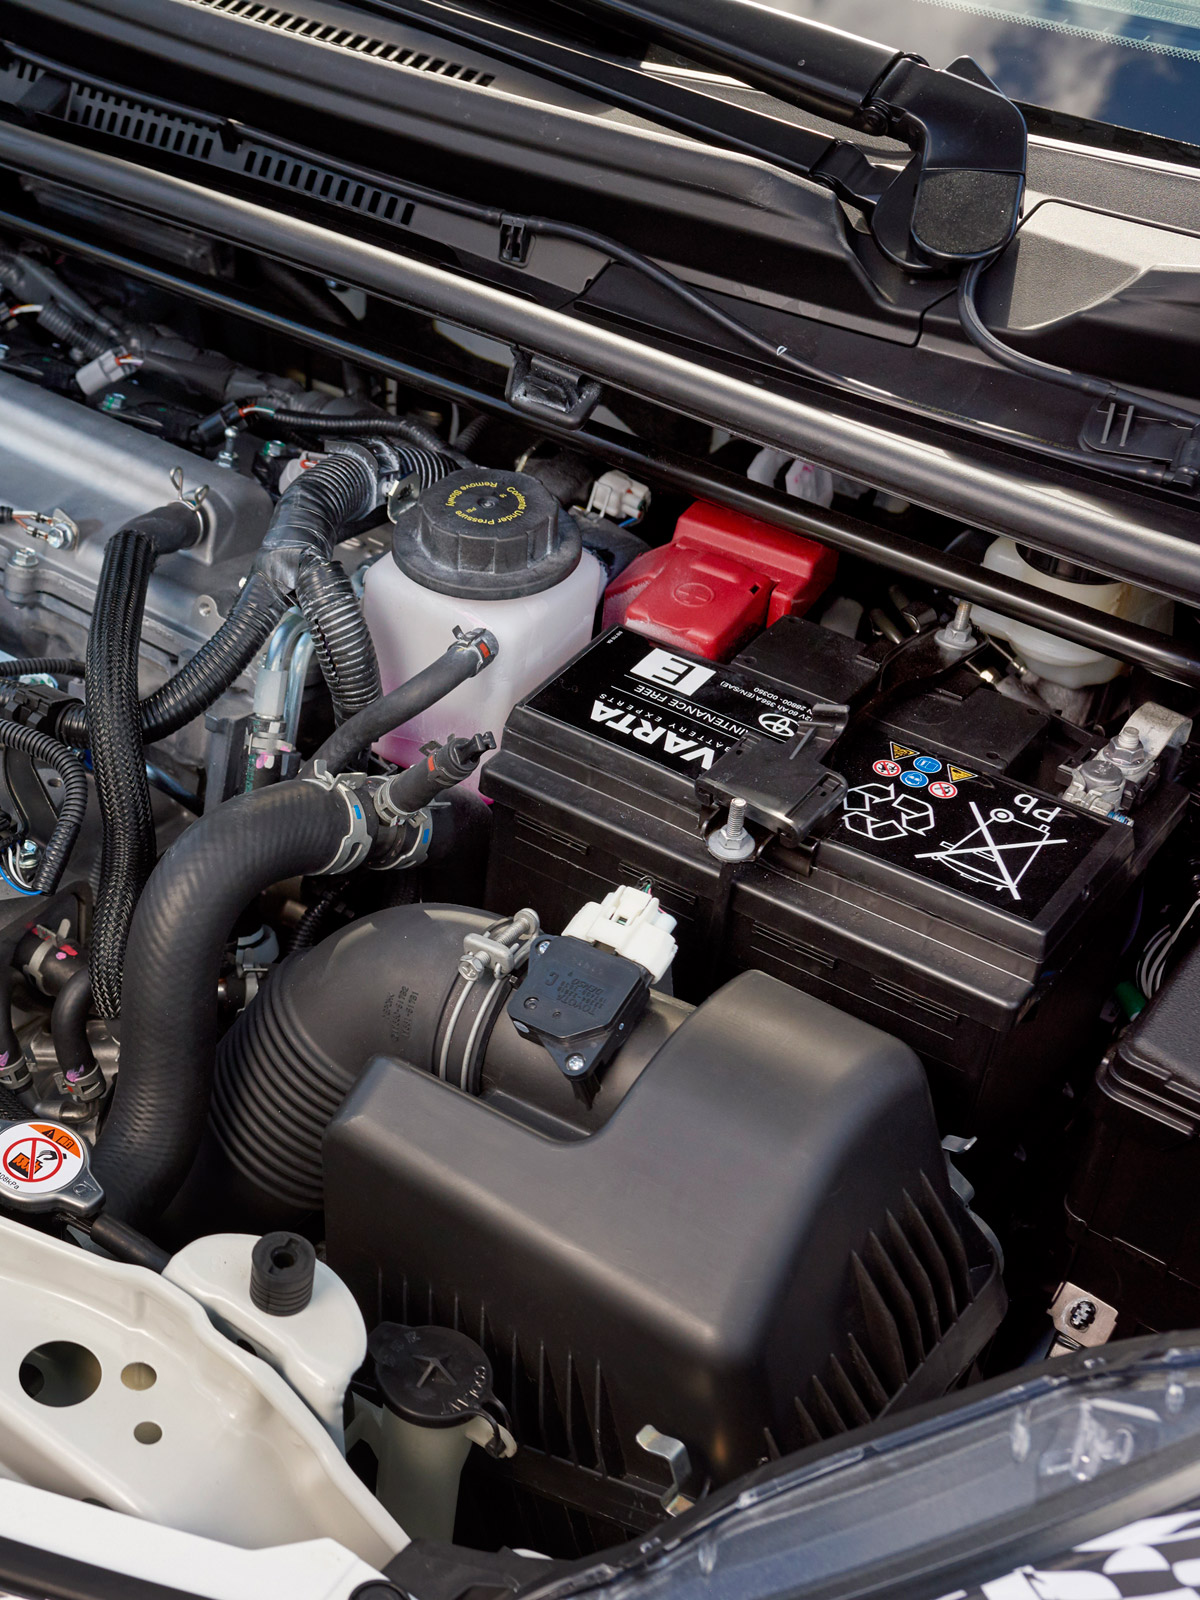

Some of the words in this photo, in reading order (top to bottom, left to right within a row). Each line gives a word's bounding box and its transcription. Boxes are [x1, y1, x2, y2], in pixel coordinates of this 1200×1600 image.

[460, 481, 498, 490] Remove
[444, 489, 463, 507] Slowly
[506, 486, 527, 510] Contents
[455, 509, 495, 525] Pressure
[497, 509, 524, 524] Under
[652, 657, 696, 687] E
[634, 684, 668, 703] FREE
[600, 693, 663, 723] EXPERTS
[590, 699, 716, 771] VARTA
[669, 722, 732, 753] BATTERY
[1013, 793, 1062, 823] Pb
[571, 978, 604, 995] DENSO
[557, 995, 595, 1016] TOYOTA
